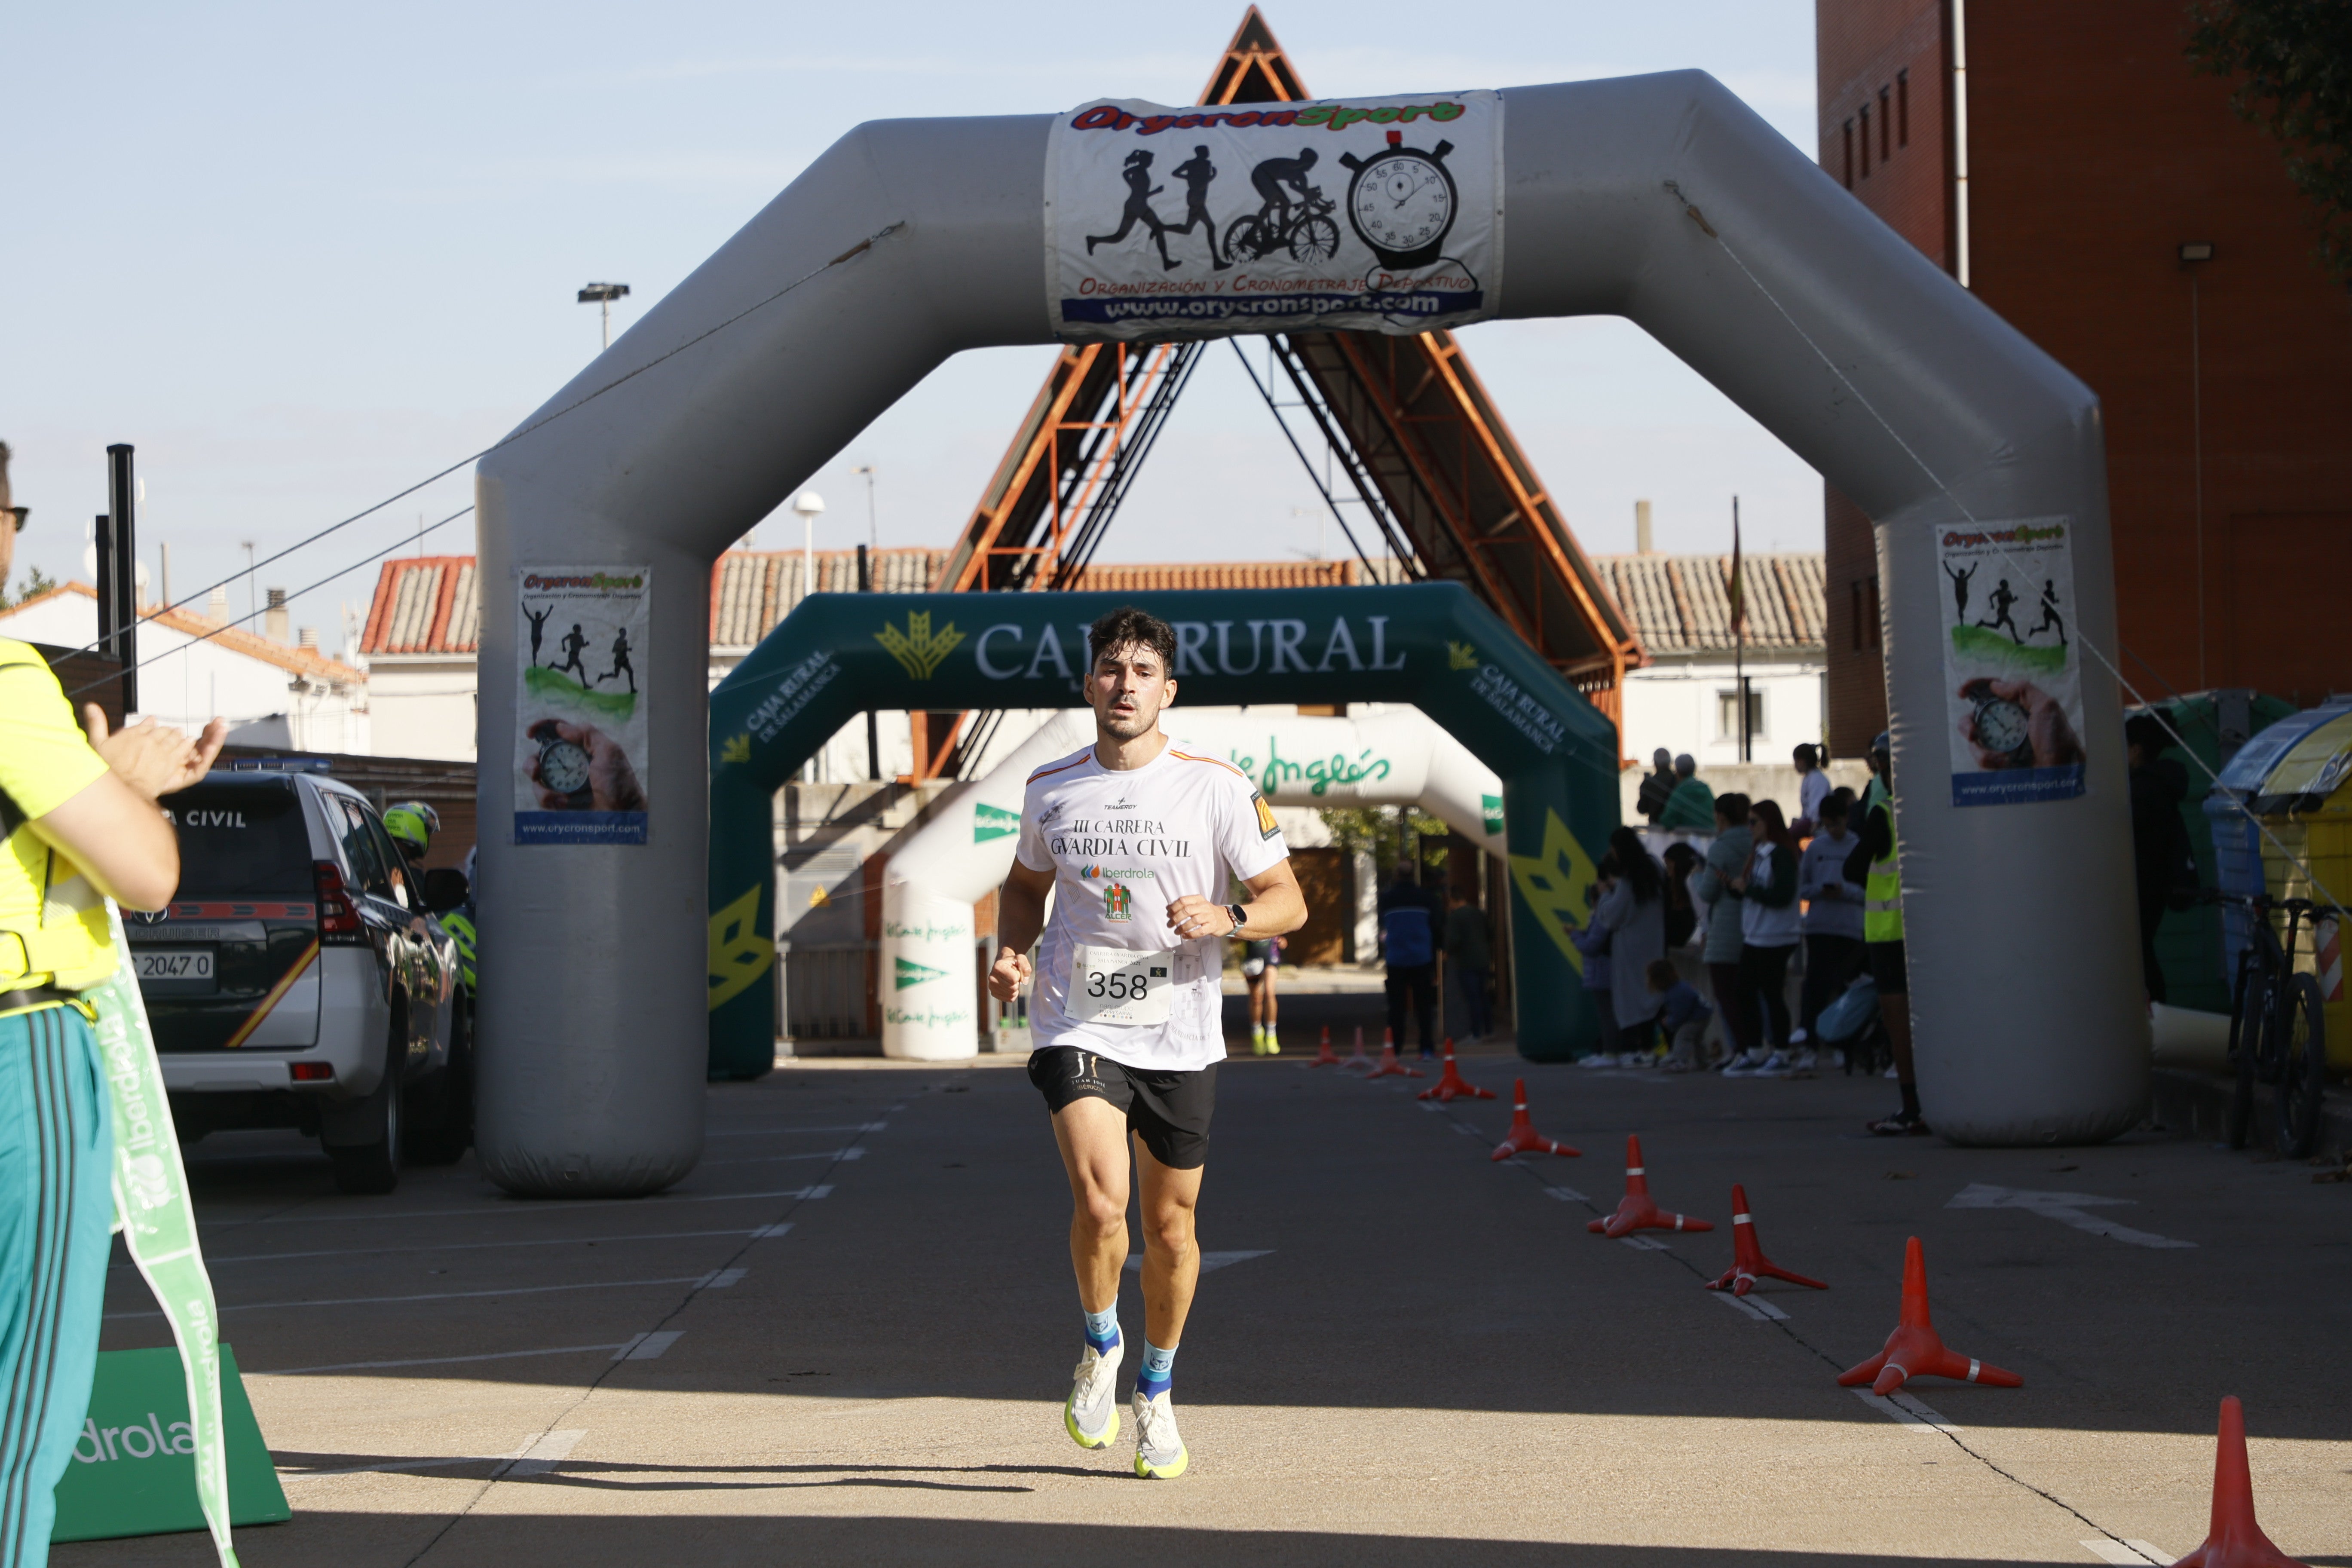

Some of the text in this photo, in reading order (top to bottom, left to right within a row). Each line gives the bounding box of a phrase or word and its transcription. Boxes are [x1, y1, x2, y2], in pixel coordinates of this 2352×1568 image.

[1071, 102, 1465, 135] OrycronSport
[1376, 169, 1387, 178] 55
[1393, 162, 1404, 171] 60
[1367, 183, 1378, 191] 50
[1363, 203, 1375, 211] 45
[1430, 213, 1440, 222] 20
[1385, 232, 1396, 241] 35
[1403, 235, 1414, 244] 30
[1419, 227, 1430, 236] 25
[1105, 296, 1439, 318] www.orycronsport.com
[524, 573, 643, 591] OrycronSport
[976, 615, 1407, 693] CAJ RURAL
[746, 694, 787, 731] CAJA
[1482, 664, 1565, 743] CAJA RURAL
[1263, 735, 1390, 796] Inglés
[187, 809, 246, 828] CIVIL
[1073, 820, 1166, 835] III CARRERA
[523, 823, 640, 835] www.orycronsport.com
[1051, 838, 1192, 858] GVARDIA CIVIL
[1103, 867, 1154, 879] Iberdrola
[136, 928, 220, 940] CRUISER
[144, 956, 191, 976] 2047
[1088, 972, 1147, 1000] 358
[1168, 1021, 1198, 1041] COMANDANCIA
[100, 1013, 156, 1150] Iberdrola
[73, 1412, 194, 1464] drola
